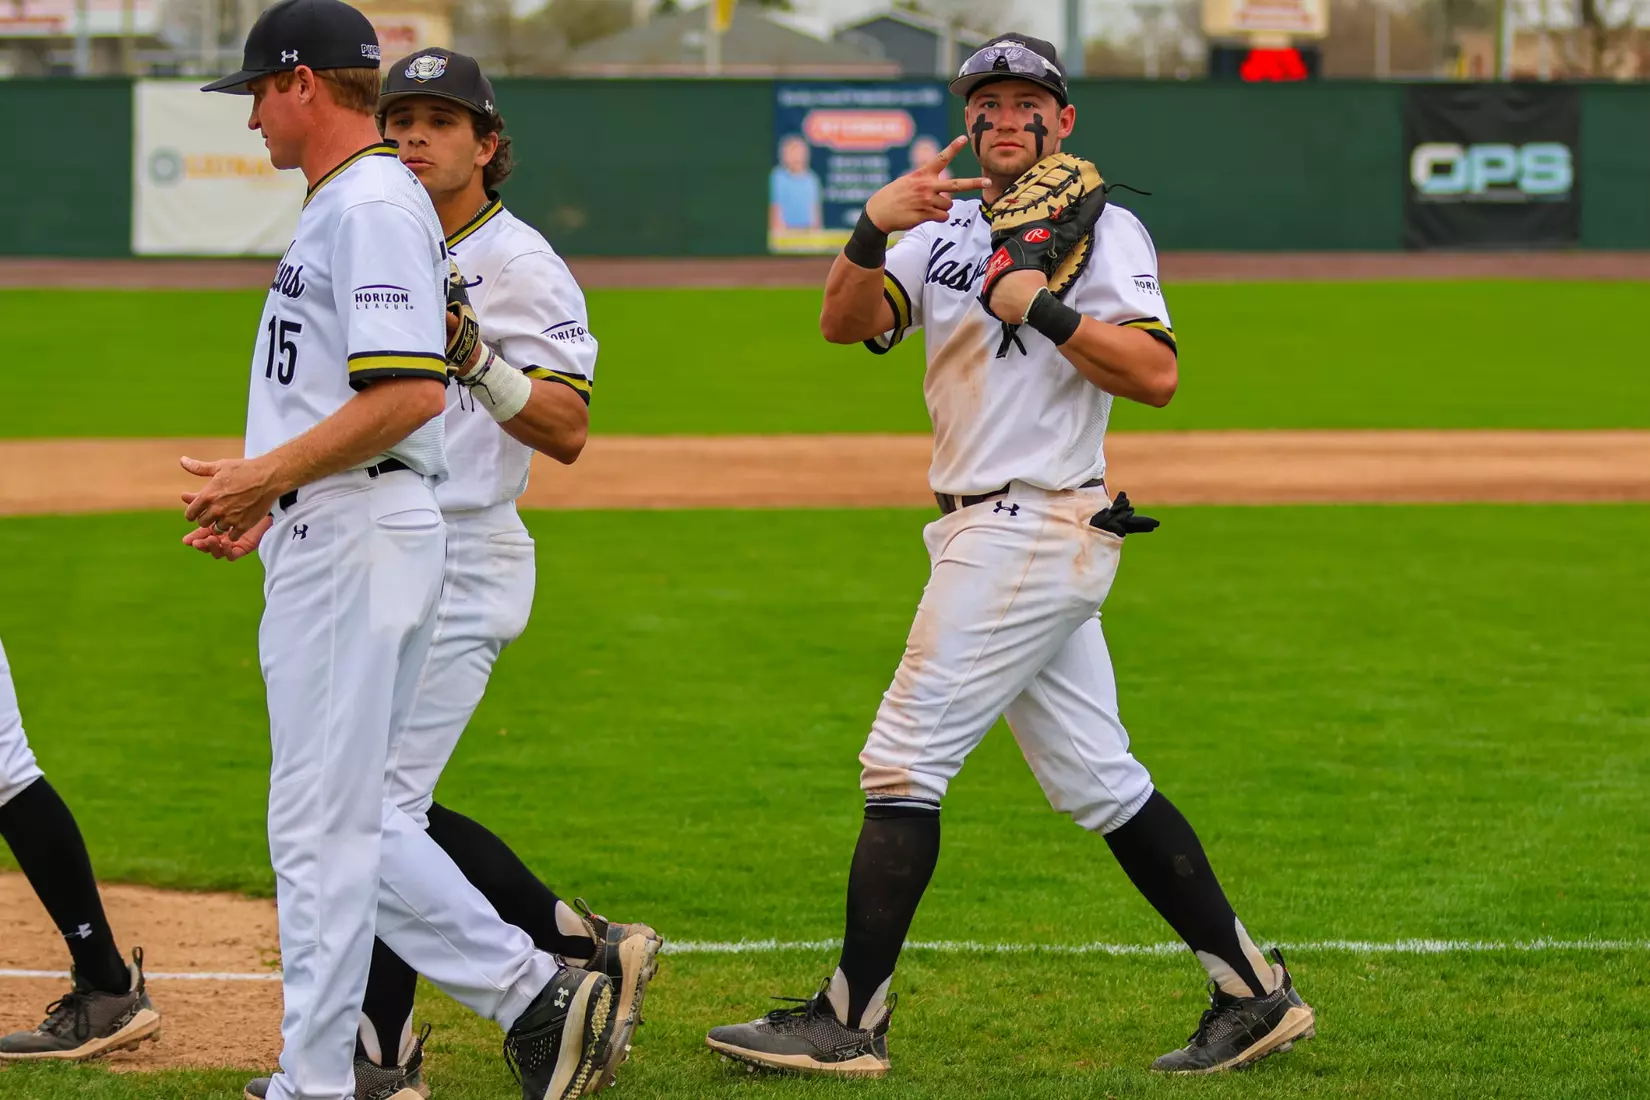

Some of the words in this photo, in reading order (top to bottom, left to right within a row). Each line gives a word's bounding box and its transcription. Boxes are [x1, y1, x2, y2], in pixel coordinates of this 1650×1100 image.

[1411, 142, 1573, 194] OPS
[1133, 278, 1160, 291] HORI
[354, 292, 409, 303] HORIZON
[550, 326, 588, 341] ORIZO
[265, 315, 303, 386] 15
